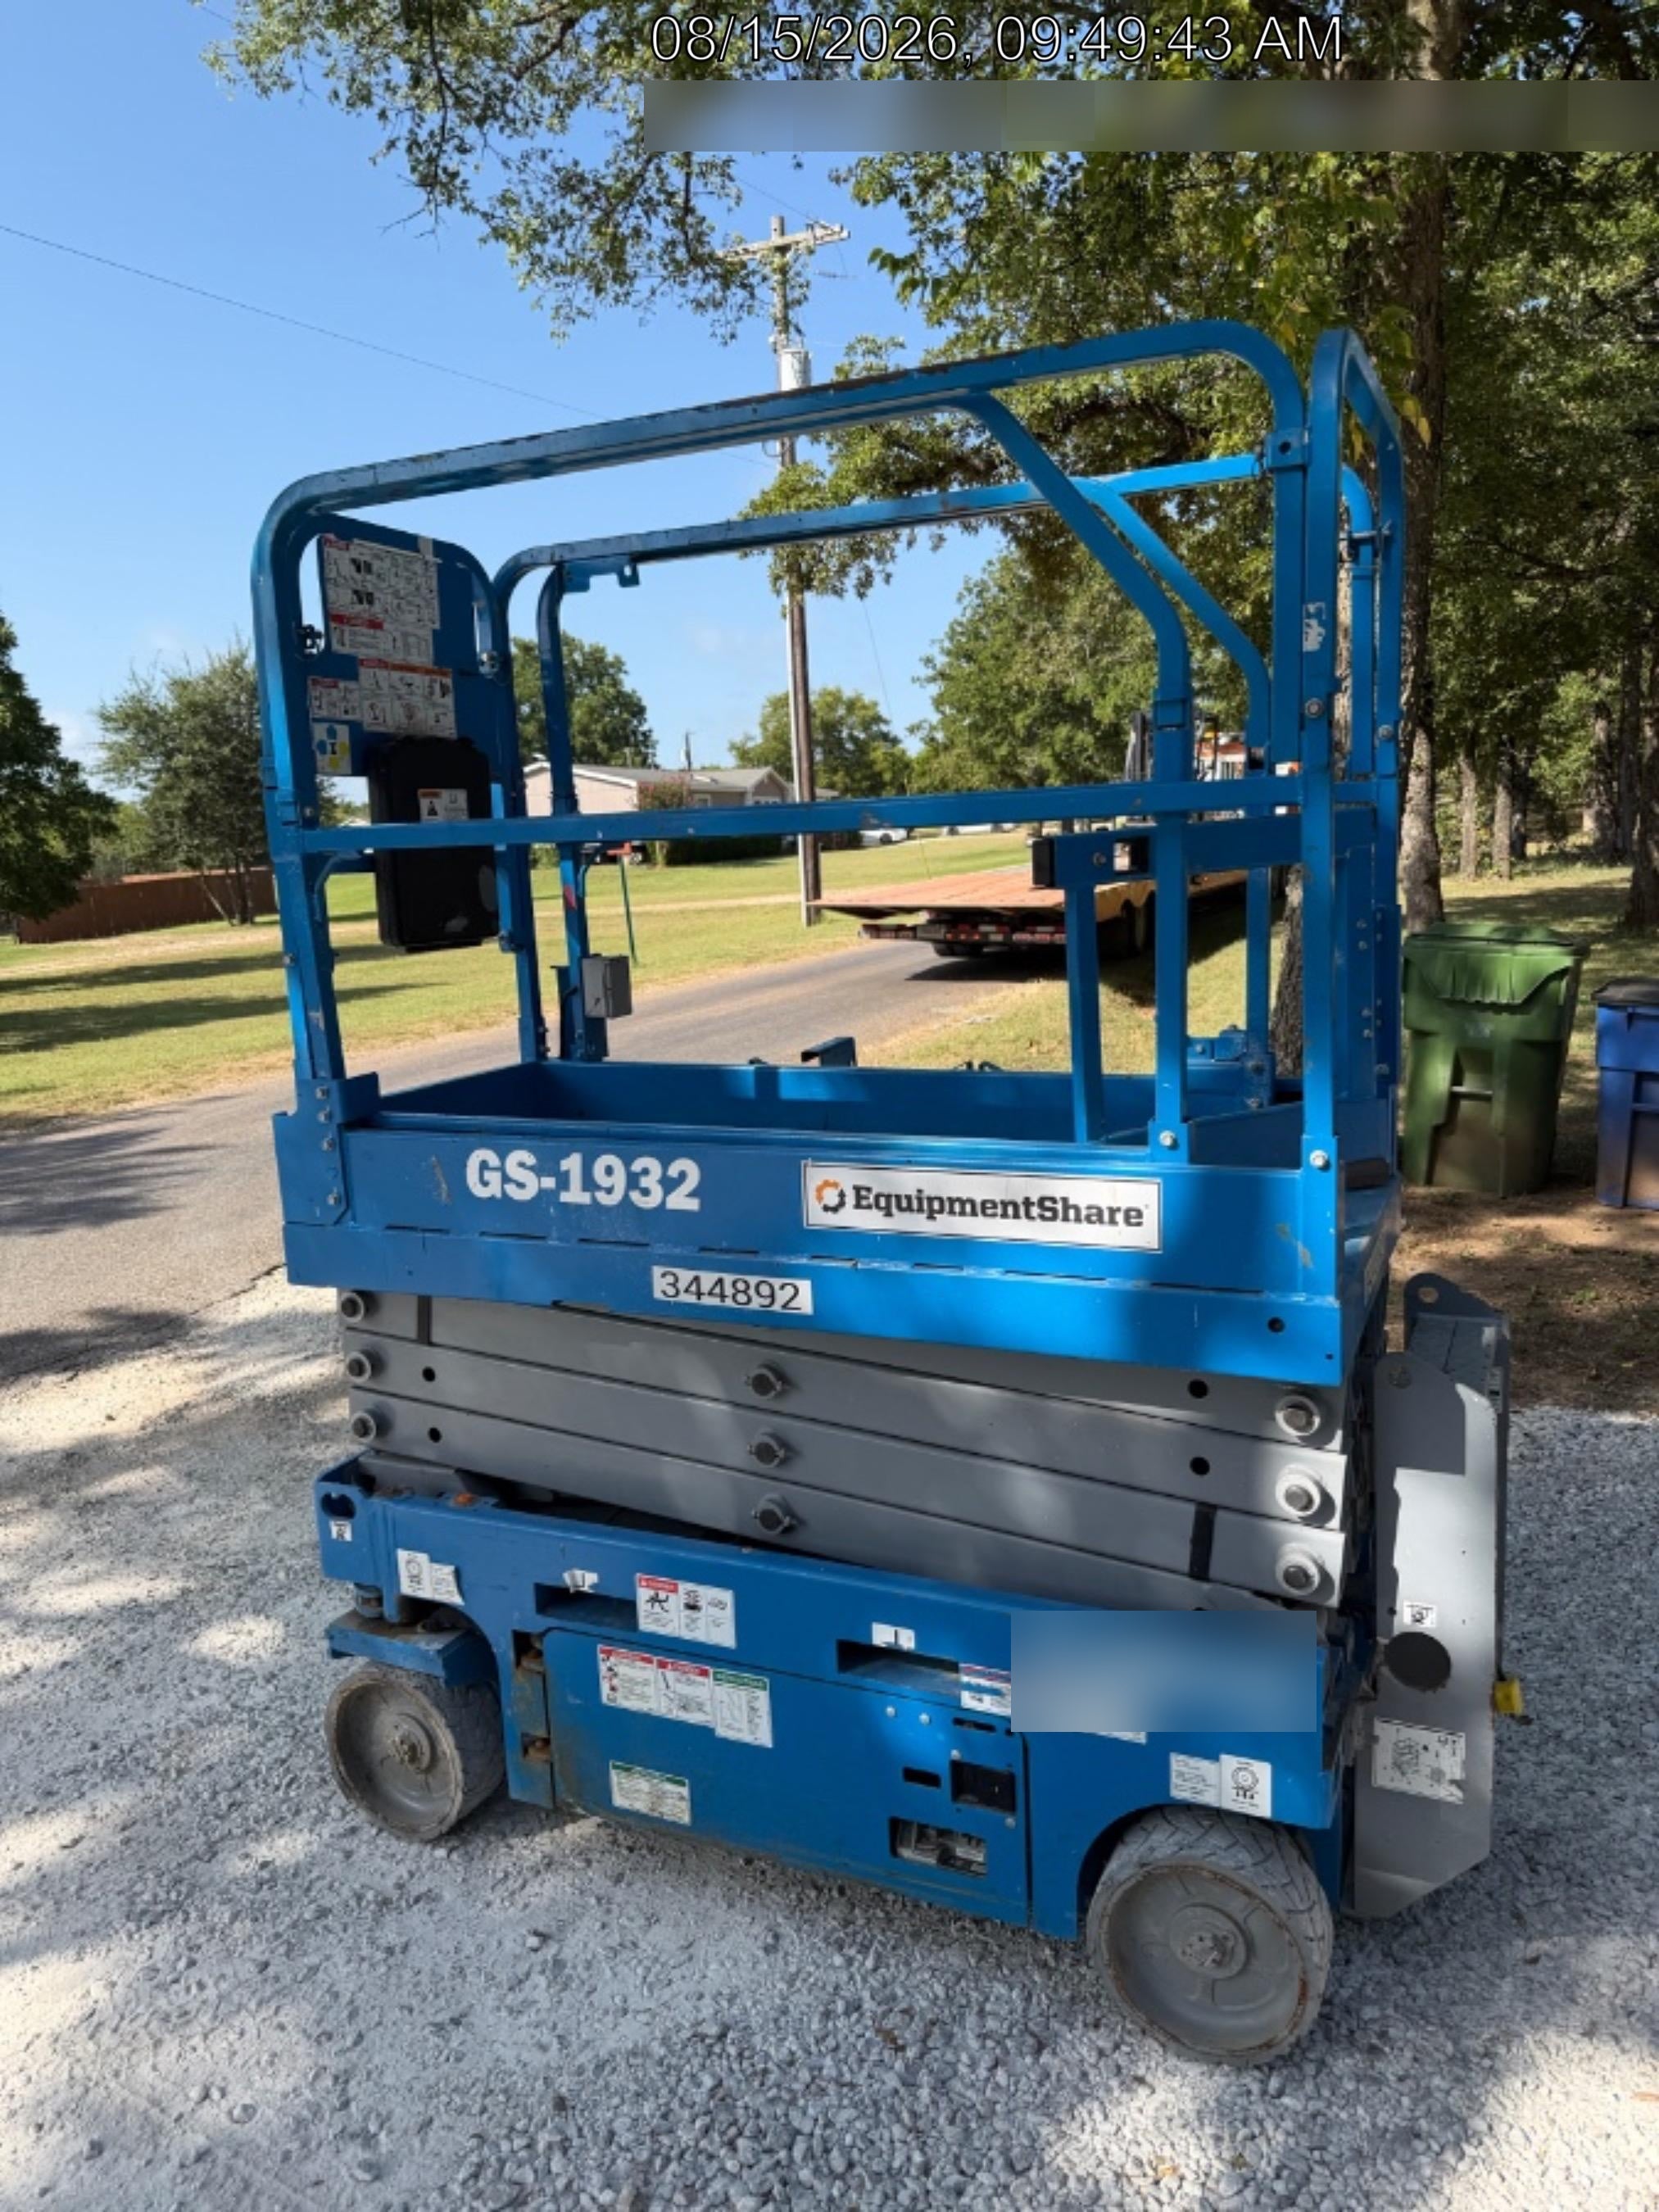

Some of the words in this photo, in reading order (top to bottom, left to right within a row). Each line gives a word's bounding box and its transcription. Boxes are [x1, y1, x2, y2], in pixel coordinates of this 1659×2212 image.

[466, 1149, 701, 1211] GS-1932
[853, 1185, 1145, 1227] EquipmentShare
[660, 1271, 801, 1311] 344892
